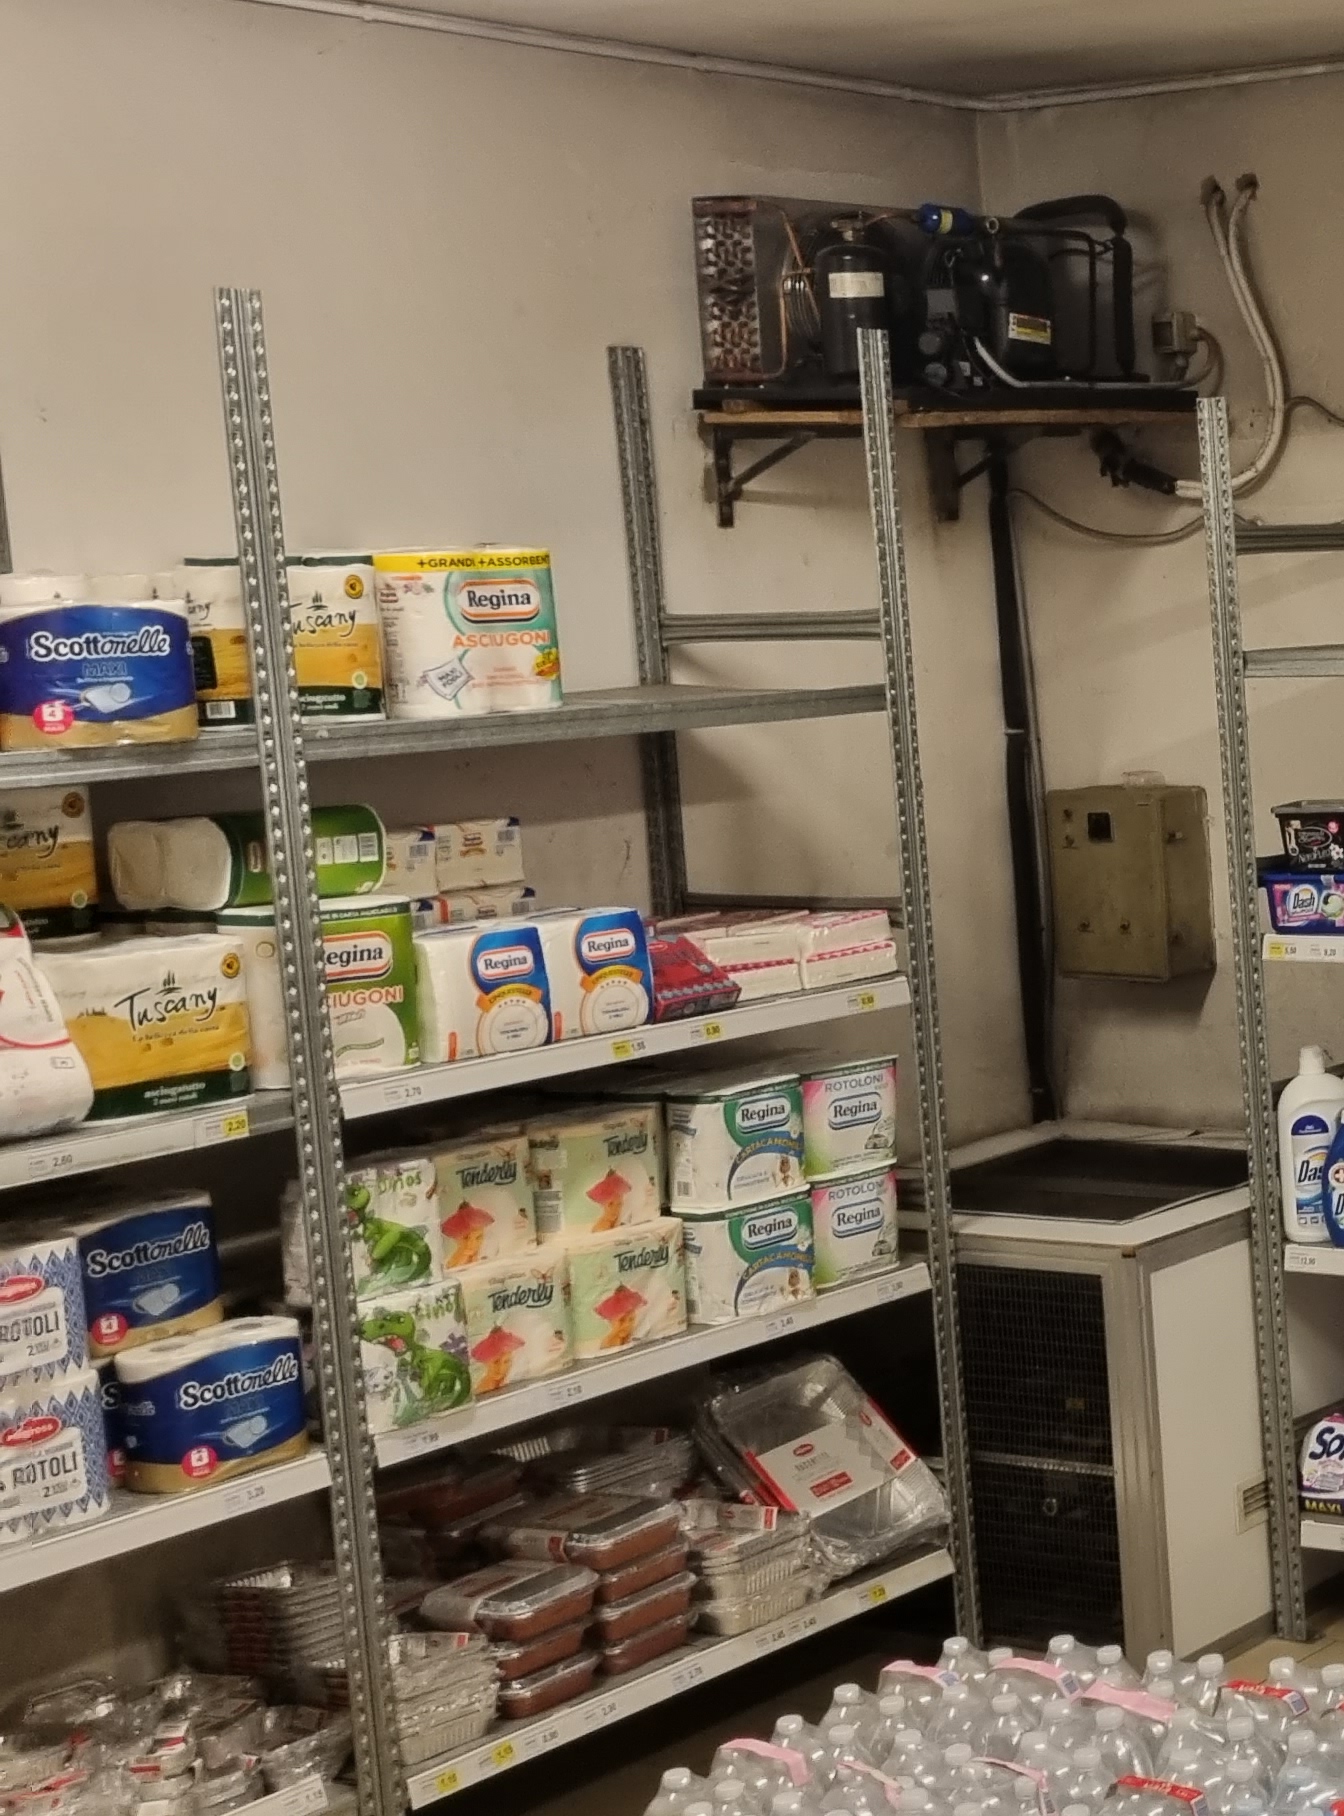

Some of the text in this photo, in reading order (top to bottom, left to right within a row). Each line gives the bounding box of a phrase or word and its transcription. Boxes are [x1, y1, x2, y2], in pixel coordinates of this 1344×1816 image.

[417, 557, 476, 569] +GRANDI
[467, 589, 531, 611] Regina
[31, 625, 171, 662] Scottonelle
[453, 630, 549, 649] ASCIUGONI
[82, 661, 128, 676] MAXI
[1292, 892, 1316, 910] Dash
[587, 936, 630, 953] Regina
[325, 944, 384, 968] egina
[484, 954, 528, 971] Regina
[114, 986, 218, 1032] Tuscany
[329, 986, 404, 1010] IUGONI
[825, 1072, 884, 1093] ROTOLONI
[741, 1104, 786, 1123] Regina
[834, 1099, 877, 1118] Regina
[603, 1131, 648, 1158] Tenderly
[456, 1161, 517, 1189] Tenderly
[1297, 1159, 1324, 1184] Das
[837, 1205, 881, 1225] Regina
[748, 1217, 793, 1238] Regina
[87, 1221, 210, 1279] Scottonelle
[613, 1245, 670, 1273] Tenderly
[488, 1283, 554, 1314] Tenderly
[179, 1352, 299, 1410] Scottonelle
